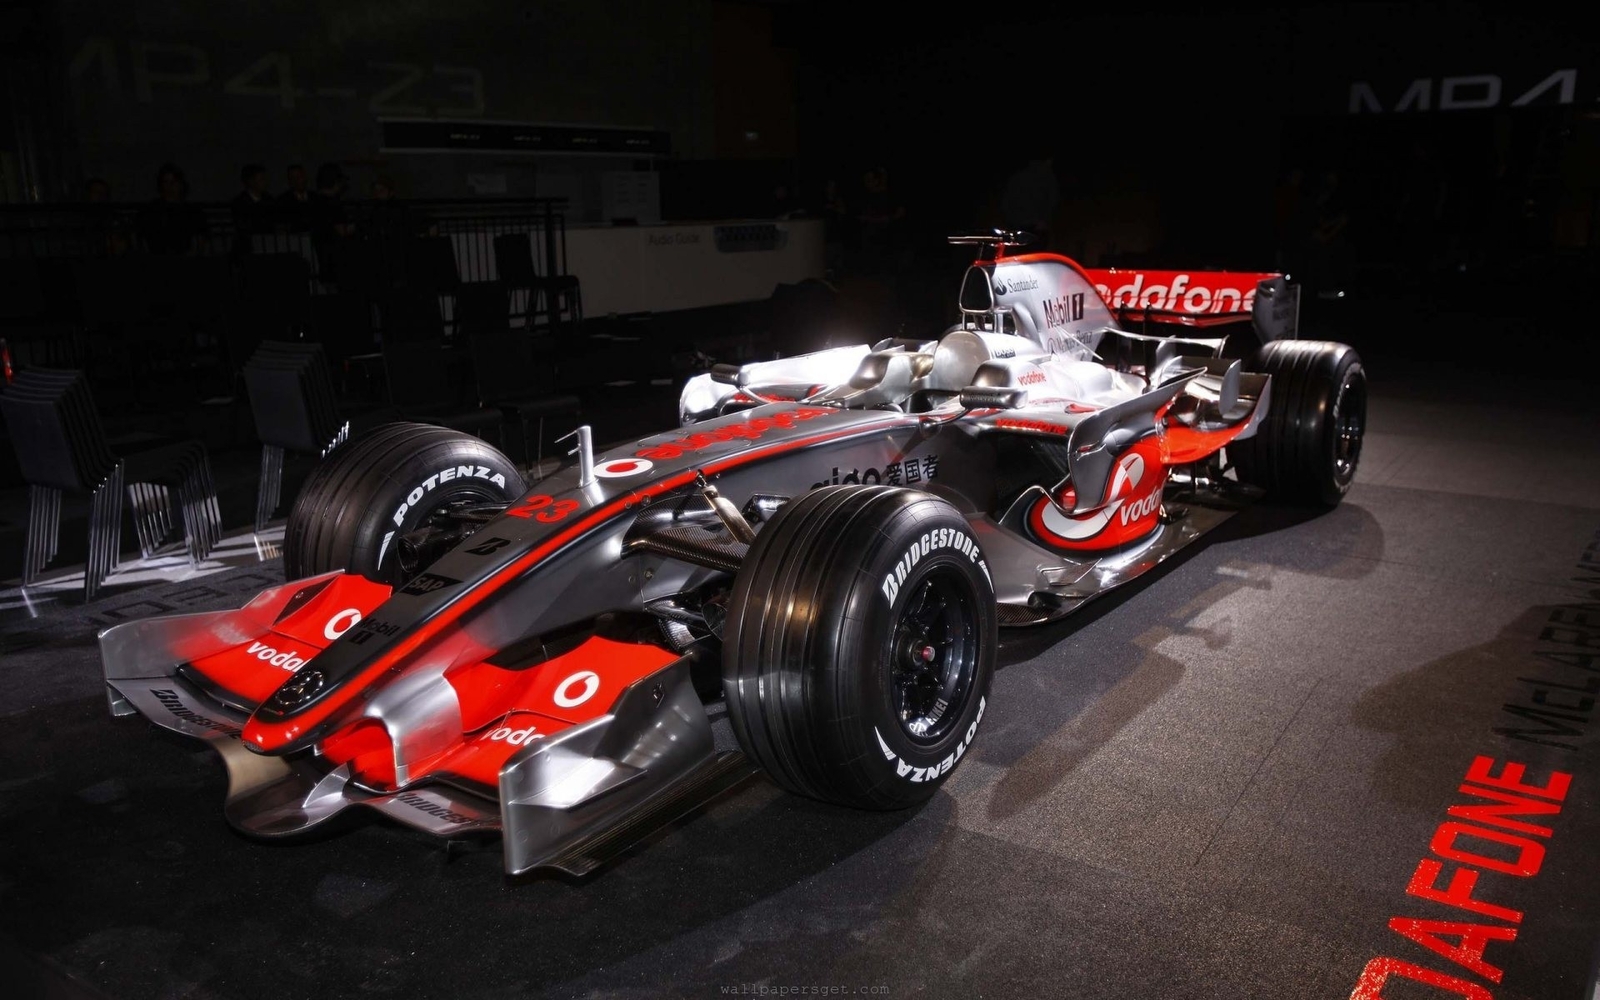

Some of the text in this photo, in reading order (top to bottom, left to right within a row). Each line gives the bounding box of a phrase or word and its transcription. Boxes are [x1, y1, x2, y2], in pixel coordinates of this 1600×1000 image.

[1007, 275, 1039, 293] Santander
[1043, 292, 1085, 329] Mobil 1
[1017, 372, 1047, 387] vodafone
[886, 454, 939, 487] 爱国者
[393, 465, 506, 527] POTENZA
[505, 494, 580, 524] 23
[409, 574, 446, 594] SAP
[882, 528, 980, 609] BRIDGESTONE
[356, 616, 401, 637] Mobil
[149, 688, 242, 740] BRIDGESTONE
[896, 696, 986, 783] POTENZA
